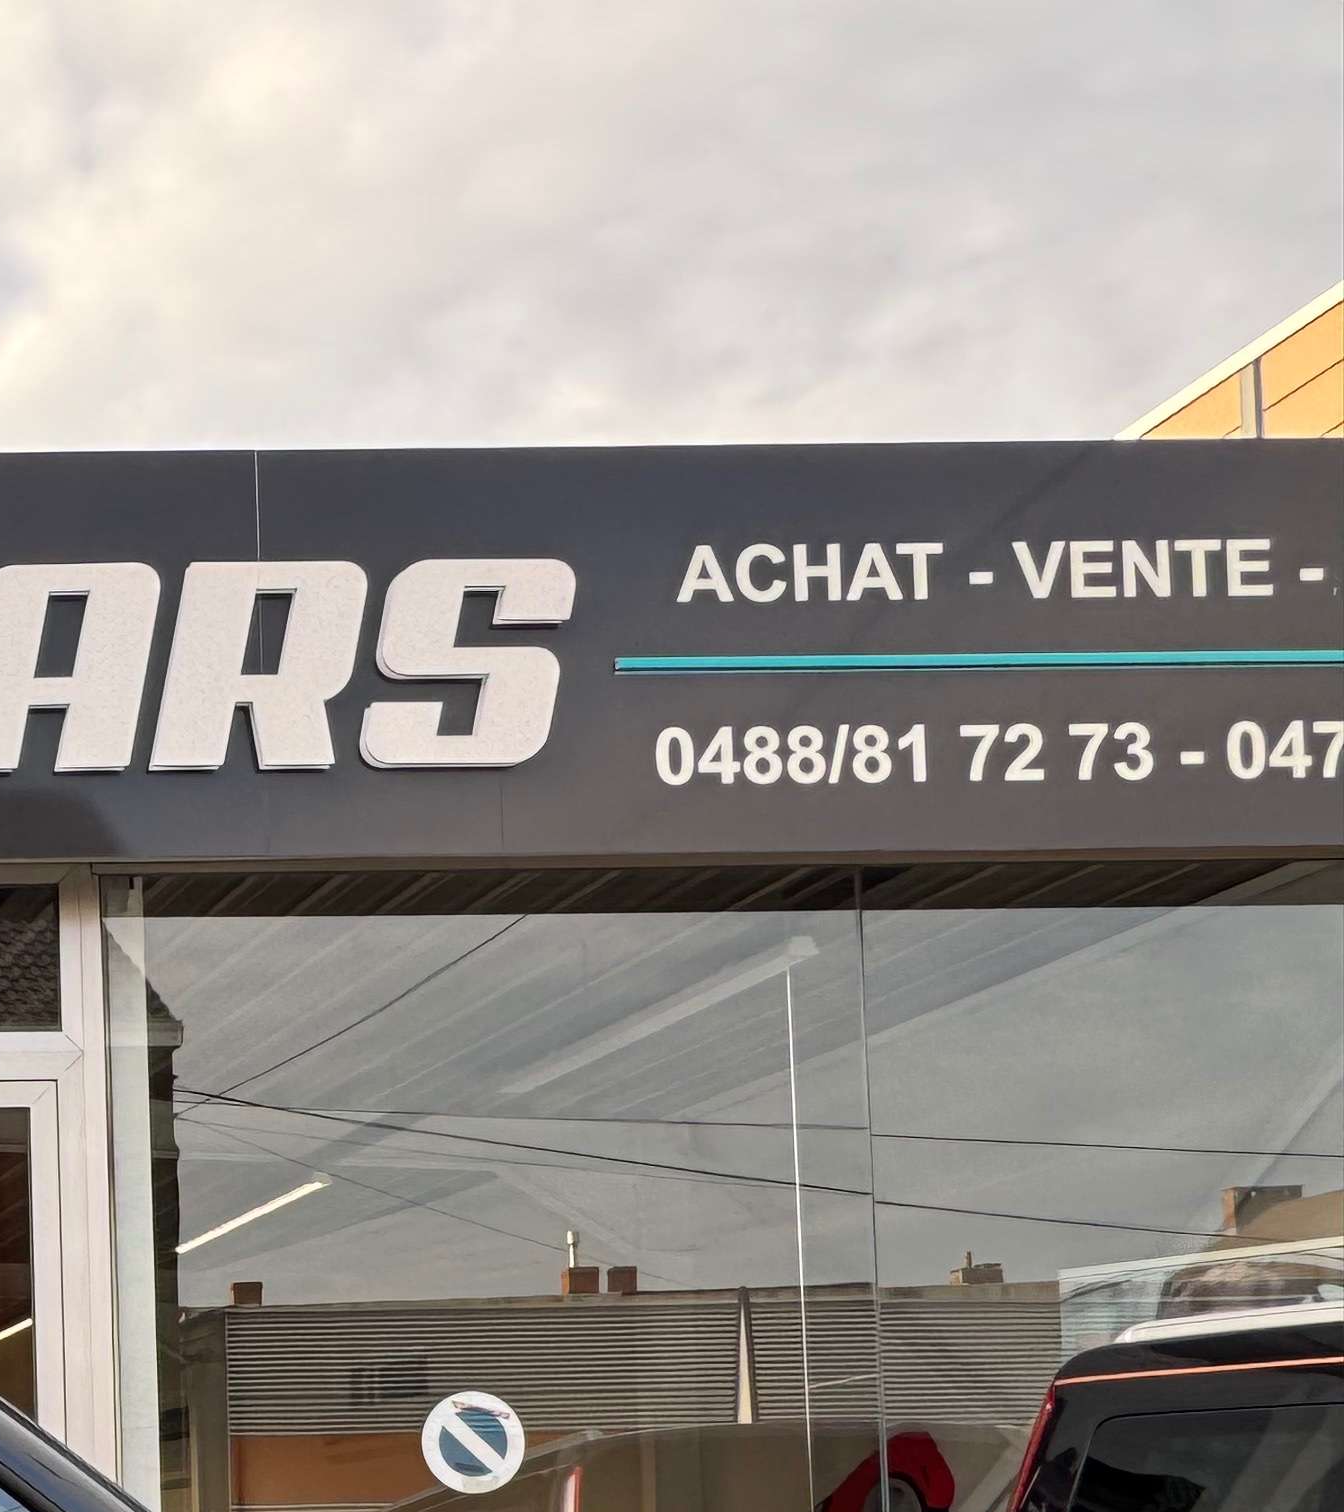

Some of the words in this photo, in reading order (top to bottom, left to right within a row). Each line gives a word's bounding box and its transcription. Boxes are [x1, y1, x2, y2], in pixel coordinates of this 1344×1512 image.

[676, 542, 944, 603] ACHAT
[1011, 538, 1274, 599] VENTE
[655, 723, 927, 786] 0488/81
[959, 722, 1045, 782] 72
[1068, 721, 1155, 781] 73
[1226, 719, 1344, 780] 047
